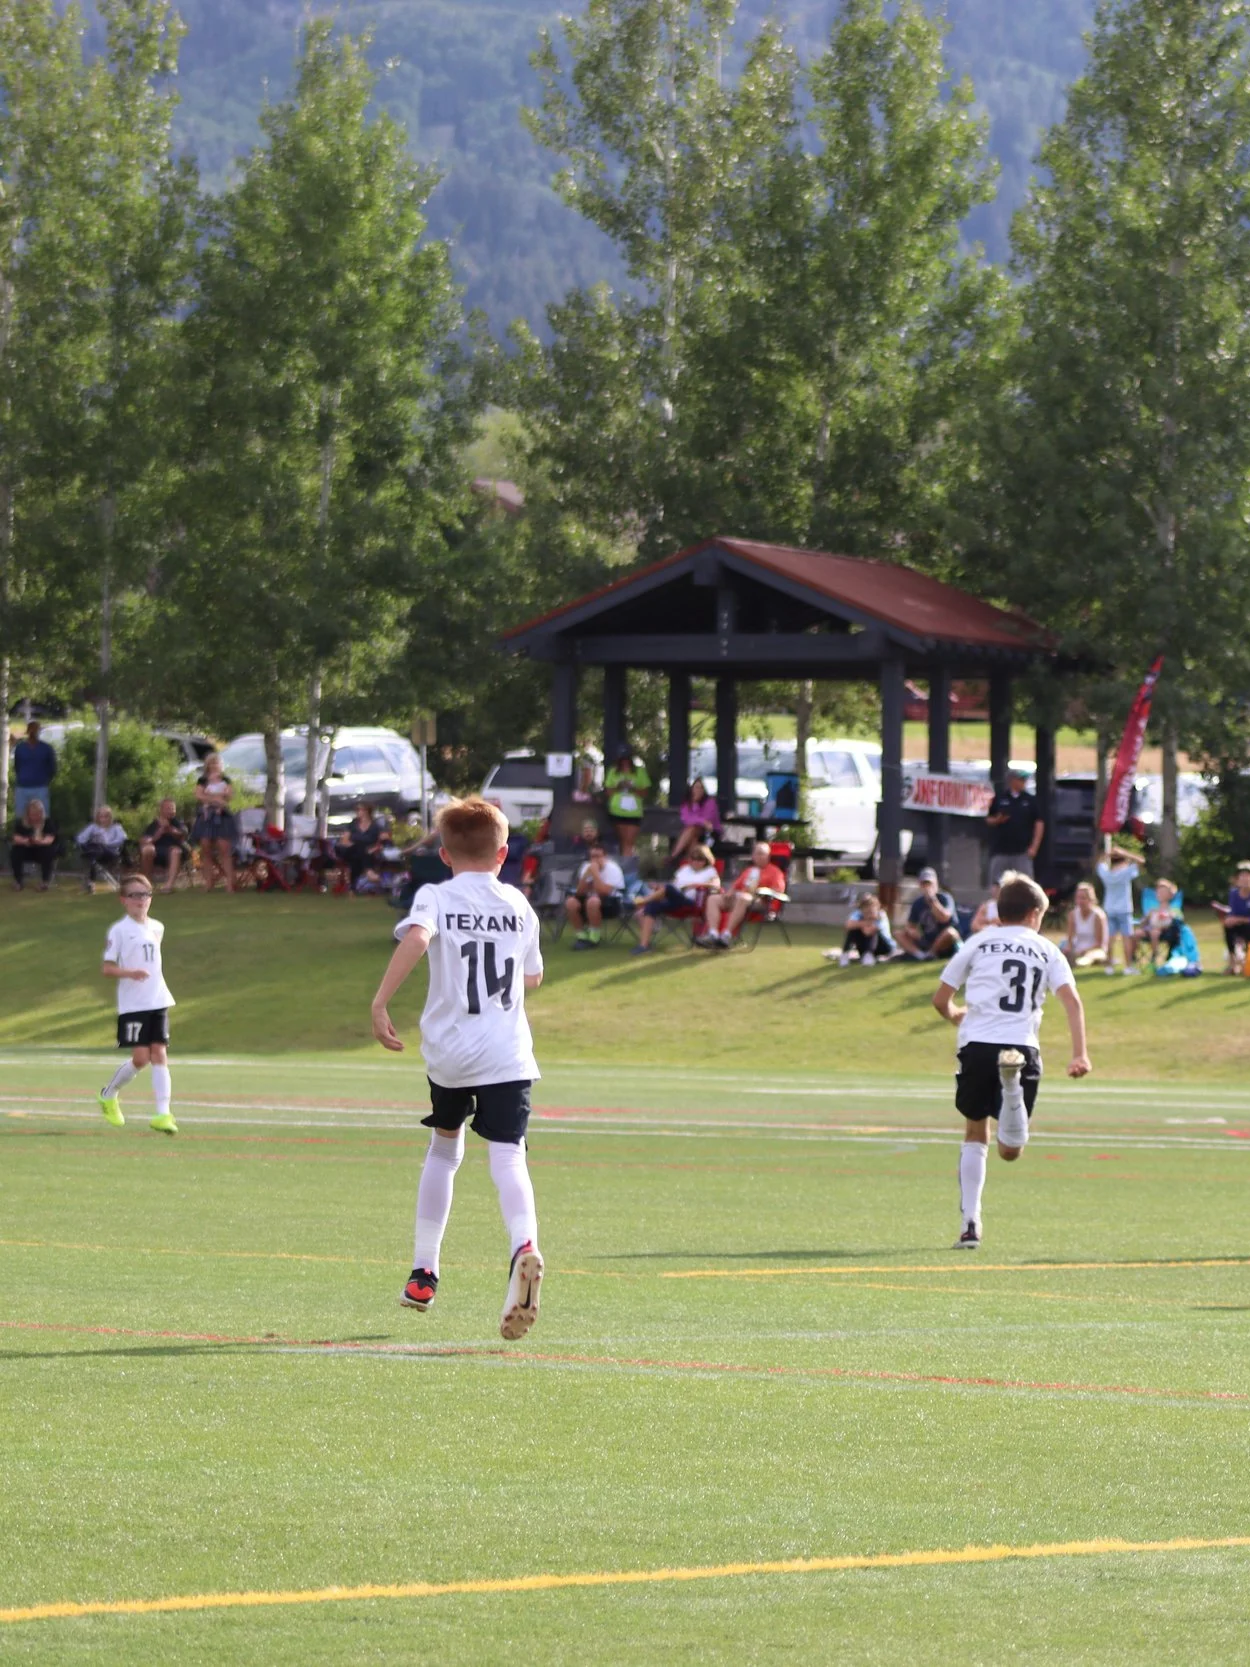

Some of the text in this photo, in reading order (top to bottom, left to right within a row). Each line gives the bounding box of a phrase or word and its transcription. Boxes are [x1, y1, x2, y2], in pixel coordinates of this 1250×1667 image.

[445, 913, 524, 933] TEXANS
[142, 943, 155, 962] 17
[978, 943, 1049, 964] TEXANS
[460, 941, 514, 1014] 14
[999, 959, 1042, 1012] 31
[126, 1021, 143, 1042] 17
